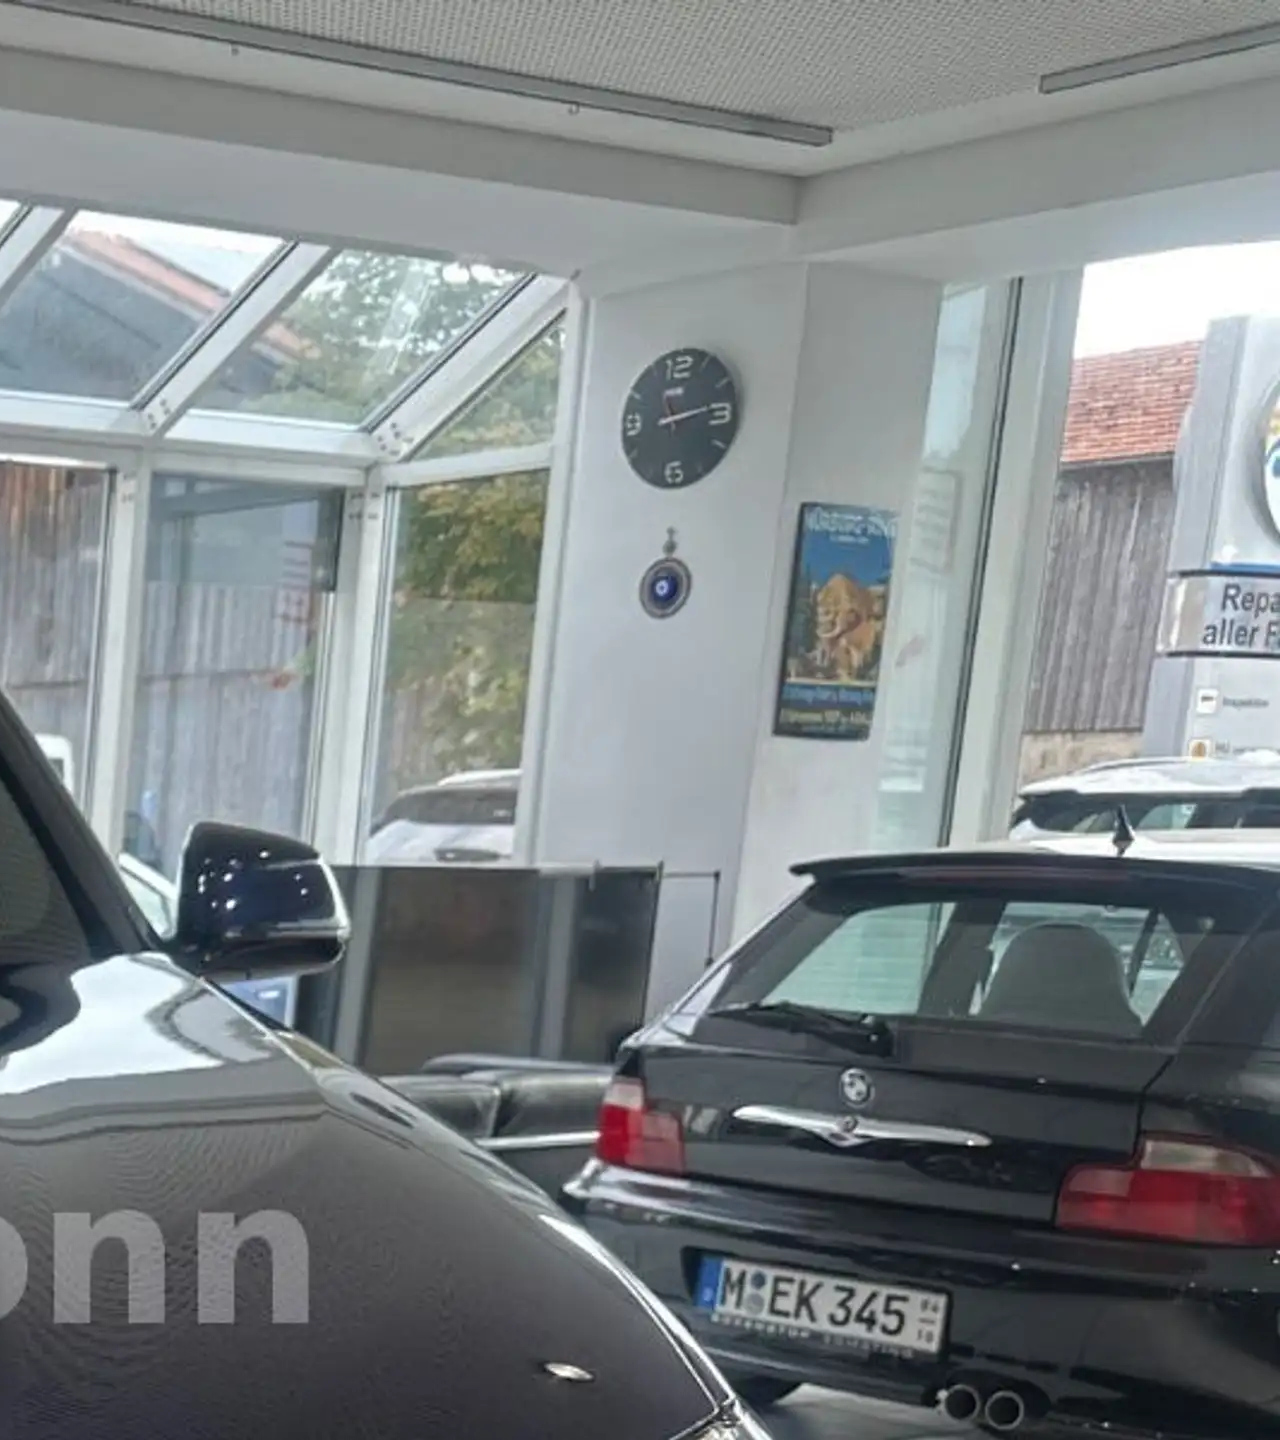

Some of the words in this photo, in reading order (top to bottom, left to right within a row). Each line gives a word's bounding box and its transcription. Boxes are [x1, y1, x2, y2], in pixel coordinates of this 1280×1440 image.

[665, 355, 693, 381] 12
[626, 414, 641, 436] 9
[708, 402, 732, 425] 3
[664, 461, 684, 484] 6
[1202, 619, 1259, 648] aller
[721, 1267, 747, 1309] M
[767, 1274, 824, 1323] EK
[827, 1285, 909, 1337] 345
